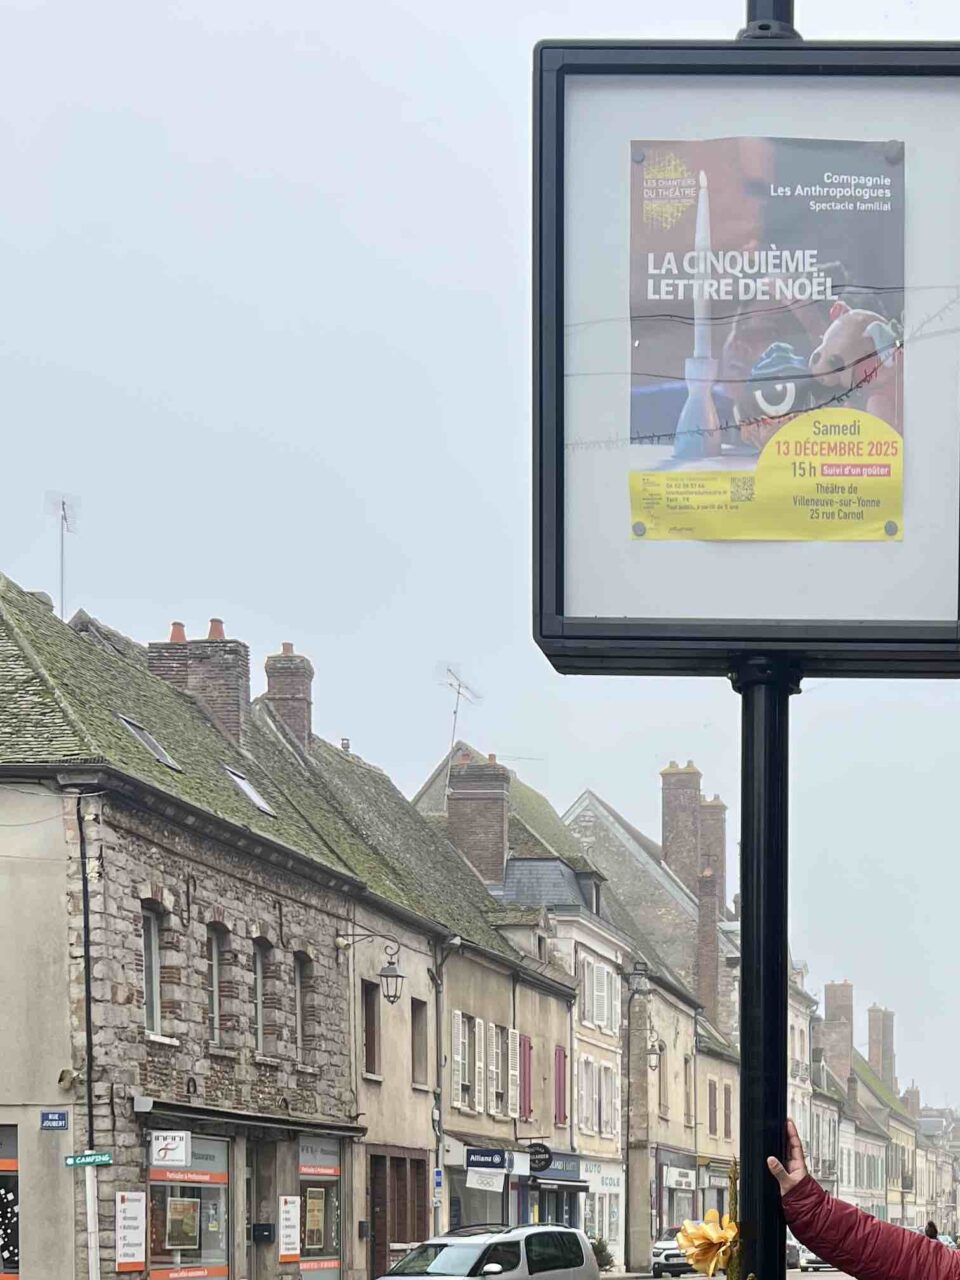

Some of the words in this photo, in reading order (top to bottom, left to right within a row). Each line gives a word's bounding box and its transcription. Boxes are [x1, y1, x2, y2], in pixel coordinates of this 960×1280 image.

[823, 172, 891, 187] Compagnie
[643, 189, 656, 197] DU
[770, 184, 791, 196] Les
[794, 184, 891, 199] Anthropologues
[809, 201, 854, 212] Spectacle
[856, 201, 891, 211] familial
[647, 252, 678, 274] LA
[683, 243, 818, 274] CINQUIÈME
[647, 278, 733, 300] LETTRE
[738, 278, 769, 300] DE
[775, 272, 839, 300] NOËL
[813, 420, 860, 436] Samedi
[775, 441, 790, 456] 13
[794, 438, 864, 456] DÉCEMBRE
[867, 441, 898, 457] 2025
[792, 462, 806, 477] 15
[808, 462, 816, 477] h
[823, 465, 843, 475] Suivi
[844, 464, 861, 475] d'un
[862, 465, 888, 477] goûter
[816, 483, 846, 495] Théâtre
[848, 484, 858, 495] de
[793, 495, 881, 508] Villeneuve-sur-Yonne
[810, 509, 820, 520] 25
[822, 511, 836, 520] rue
[837, 509, 864, 520] Carnot
[76, 1154, 110, 1164] CAMPING
[585, 1162, 601, 1174] AUTO
[601, 1176, 620, 1186] ECOLE
